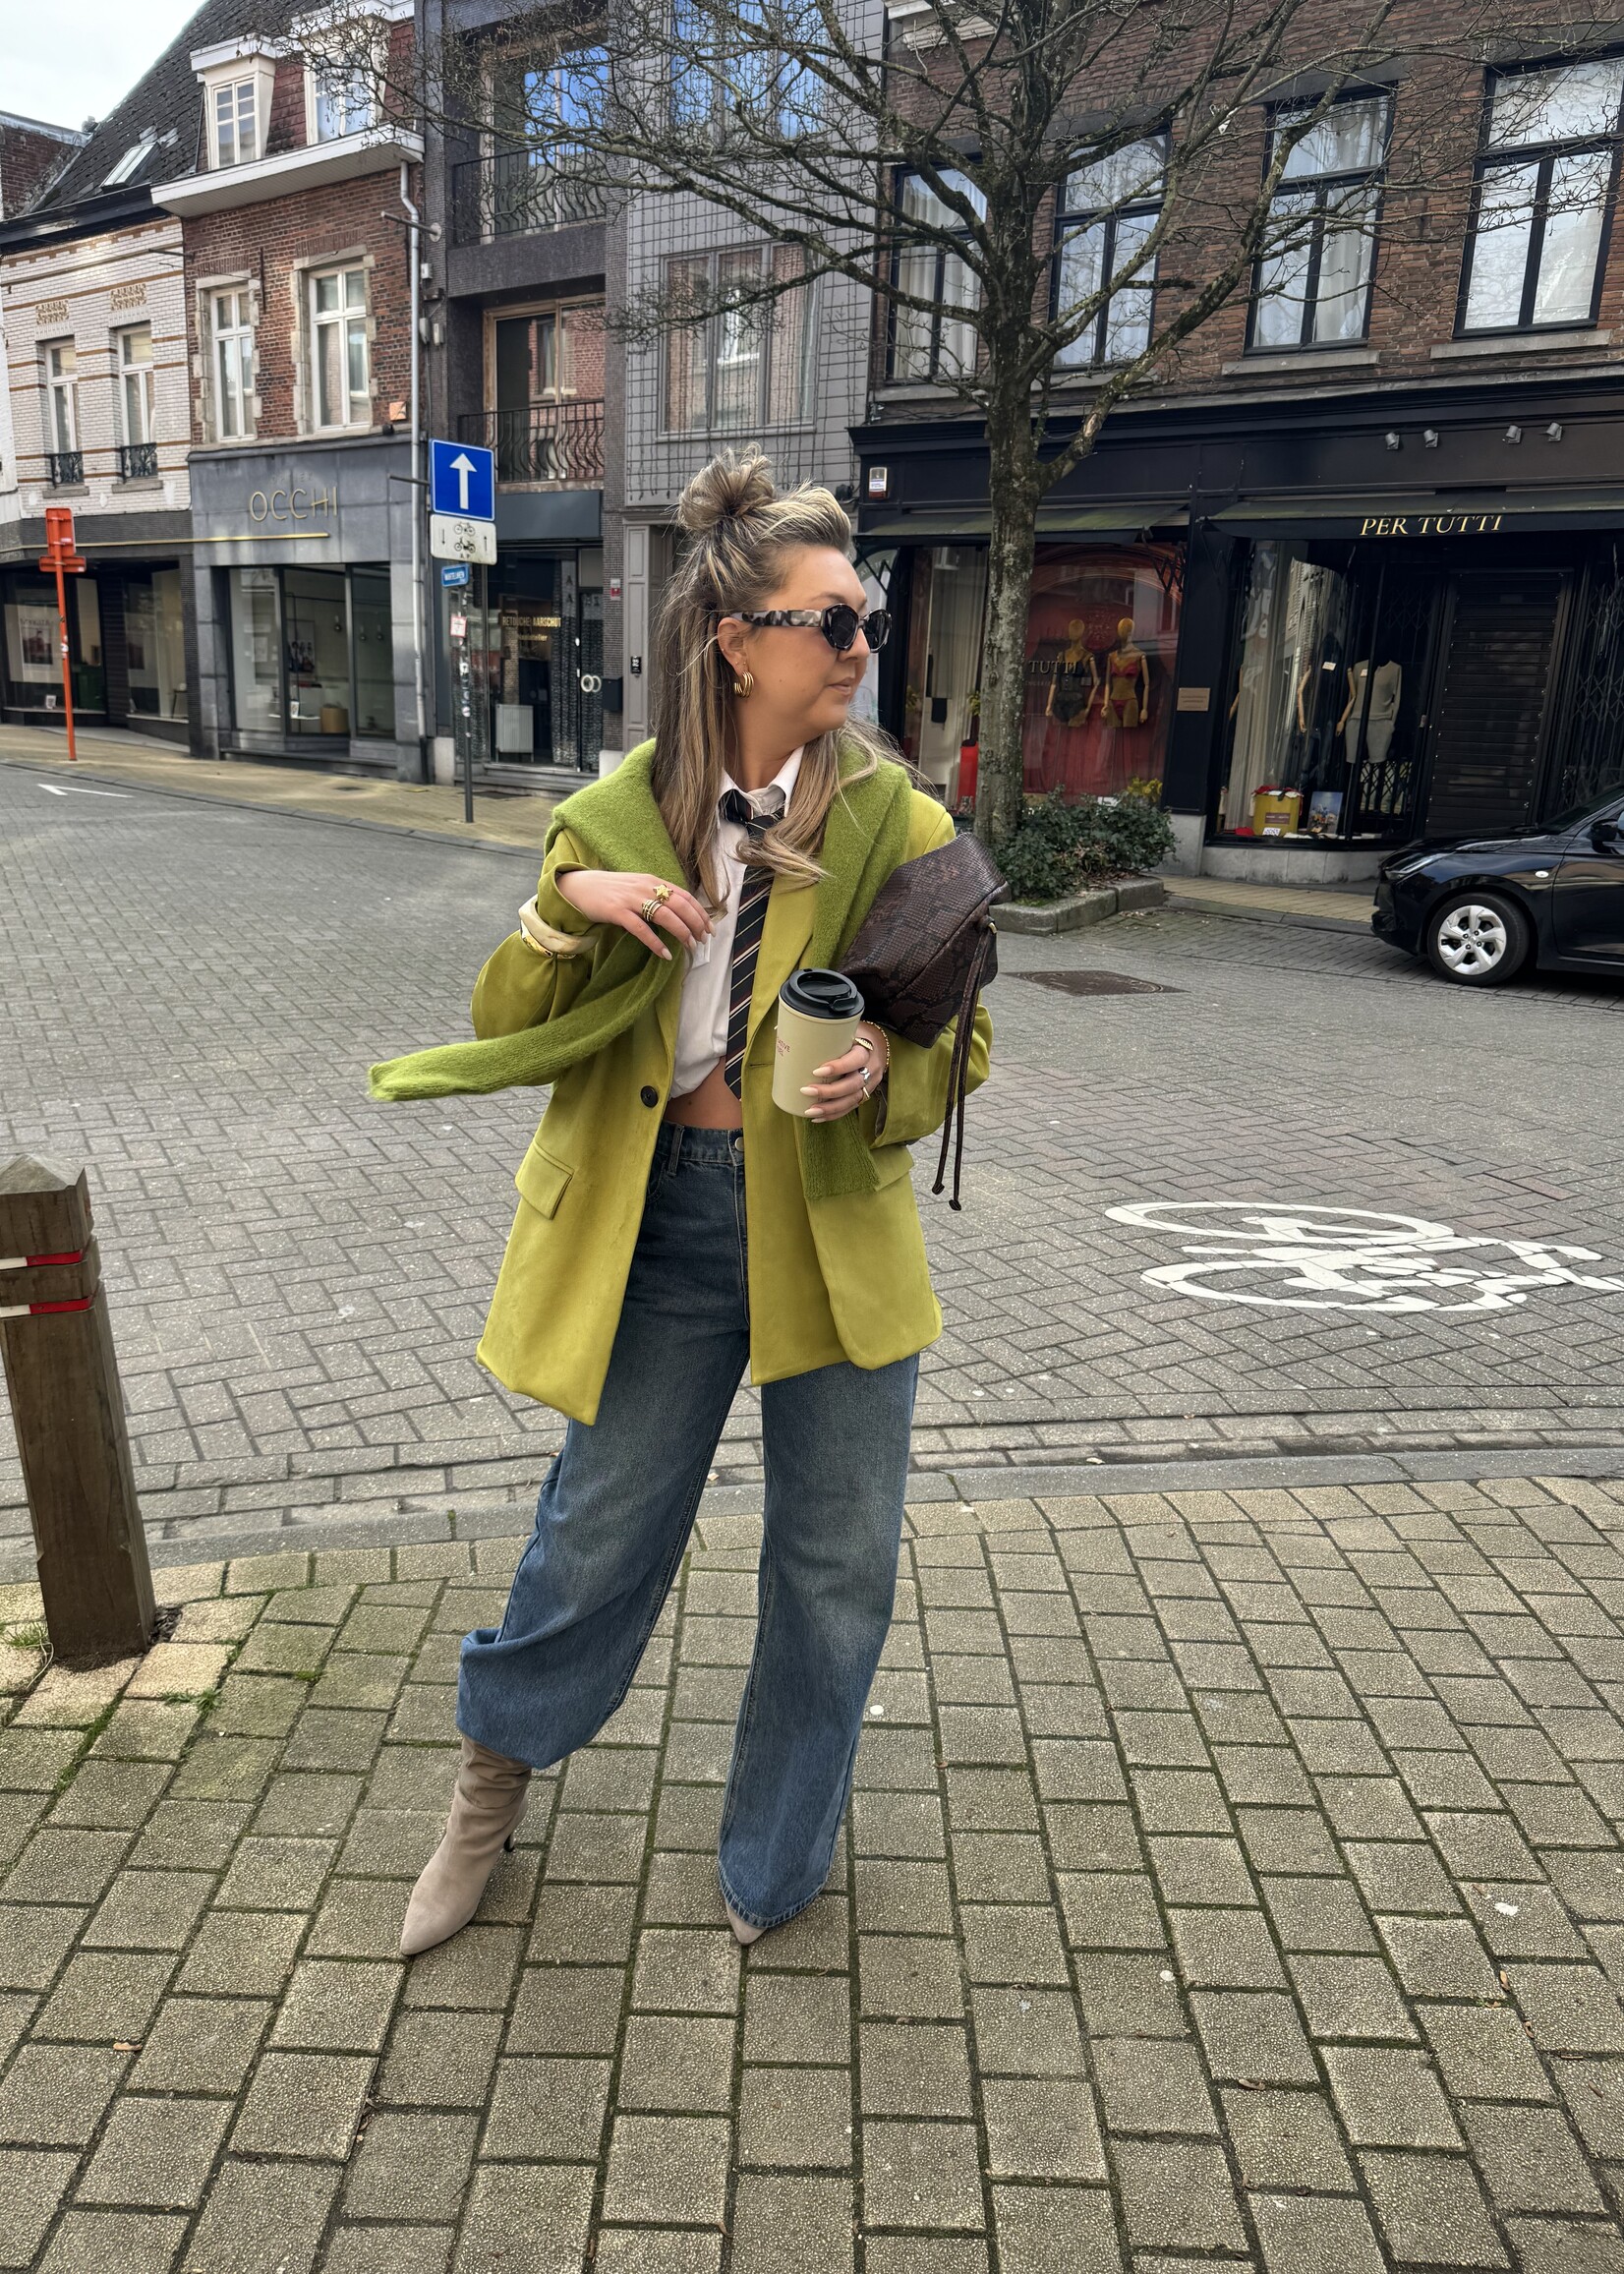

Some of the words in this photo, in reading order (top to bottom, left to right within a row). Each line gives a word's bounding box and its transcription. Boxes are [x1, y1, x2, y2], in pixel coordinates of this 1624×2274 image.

[250, 486, 337, 522] OCCHI
[1360, 517, 1408, 536] PER
[1418, 514, 1502, 534] TUTTI
[1028, 660, 1078, 674] TUTTI
